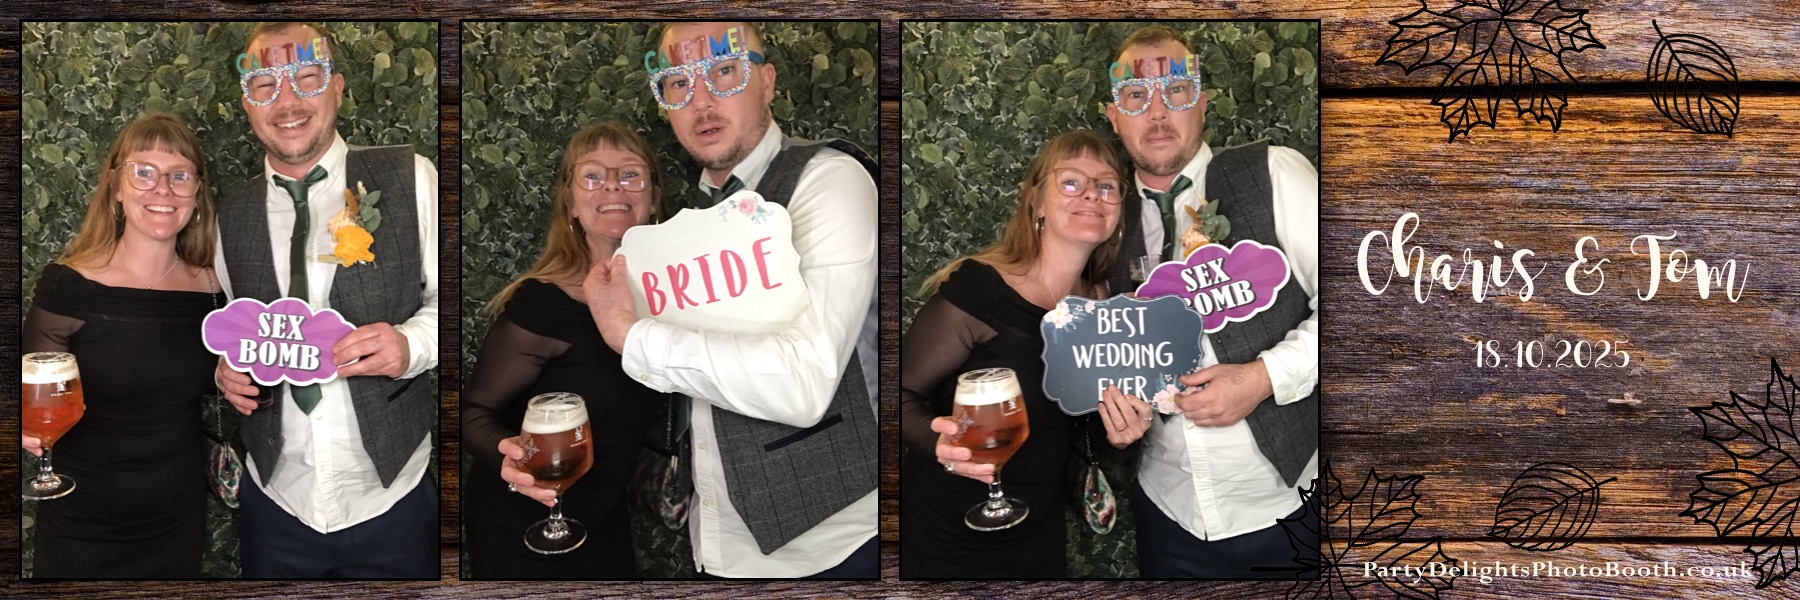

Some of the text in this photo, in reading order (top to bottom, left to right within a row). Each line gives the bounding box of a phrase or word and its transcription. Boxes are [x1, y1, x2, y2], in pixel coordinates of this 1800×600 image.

[642, 236, 783, 316] BRIDE
[1181, 257, 1231, 292] SEX
[1183, 280, 1255, 315] OMB
[257, 312, 306, 341] SEX
[1097, 307, 1148, 338] BEST
[238, 338, 321, 371] BOMB
[1072, 341, 1174, 369] WEDDING
